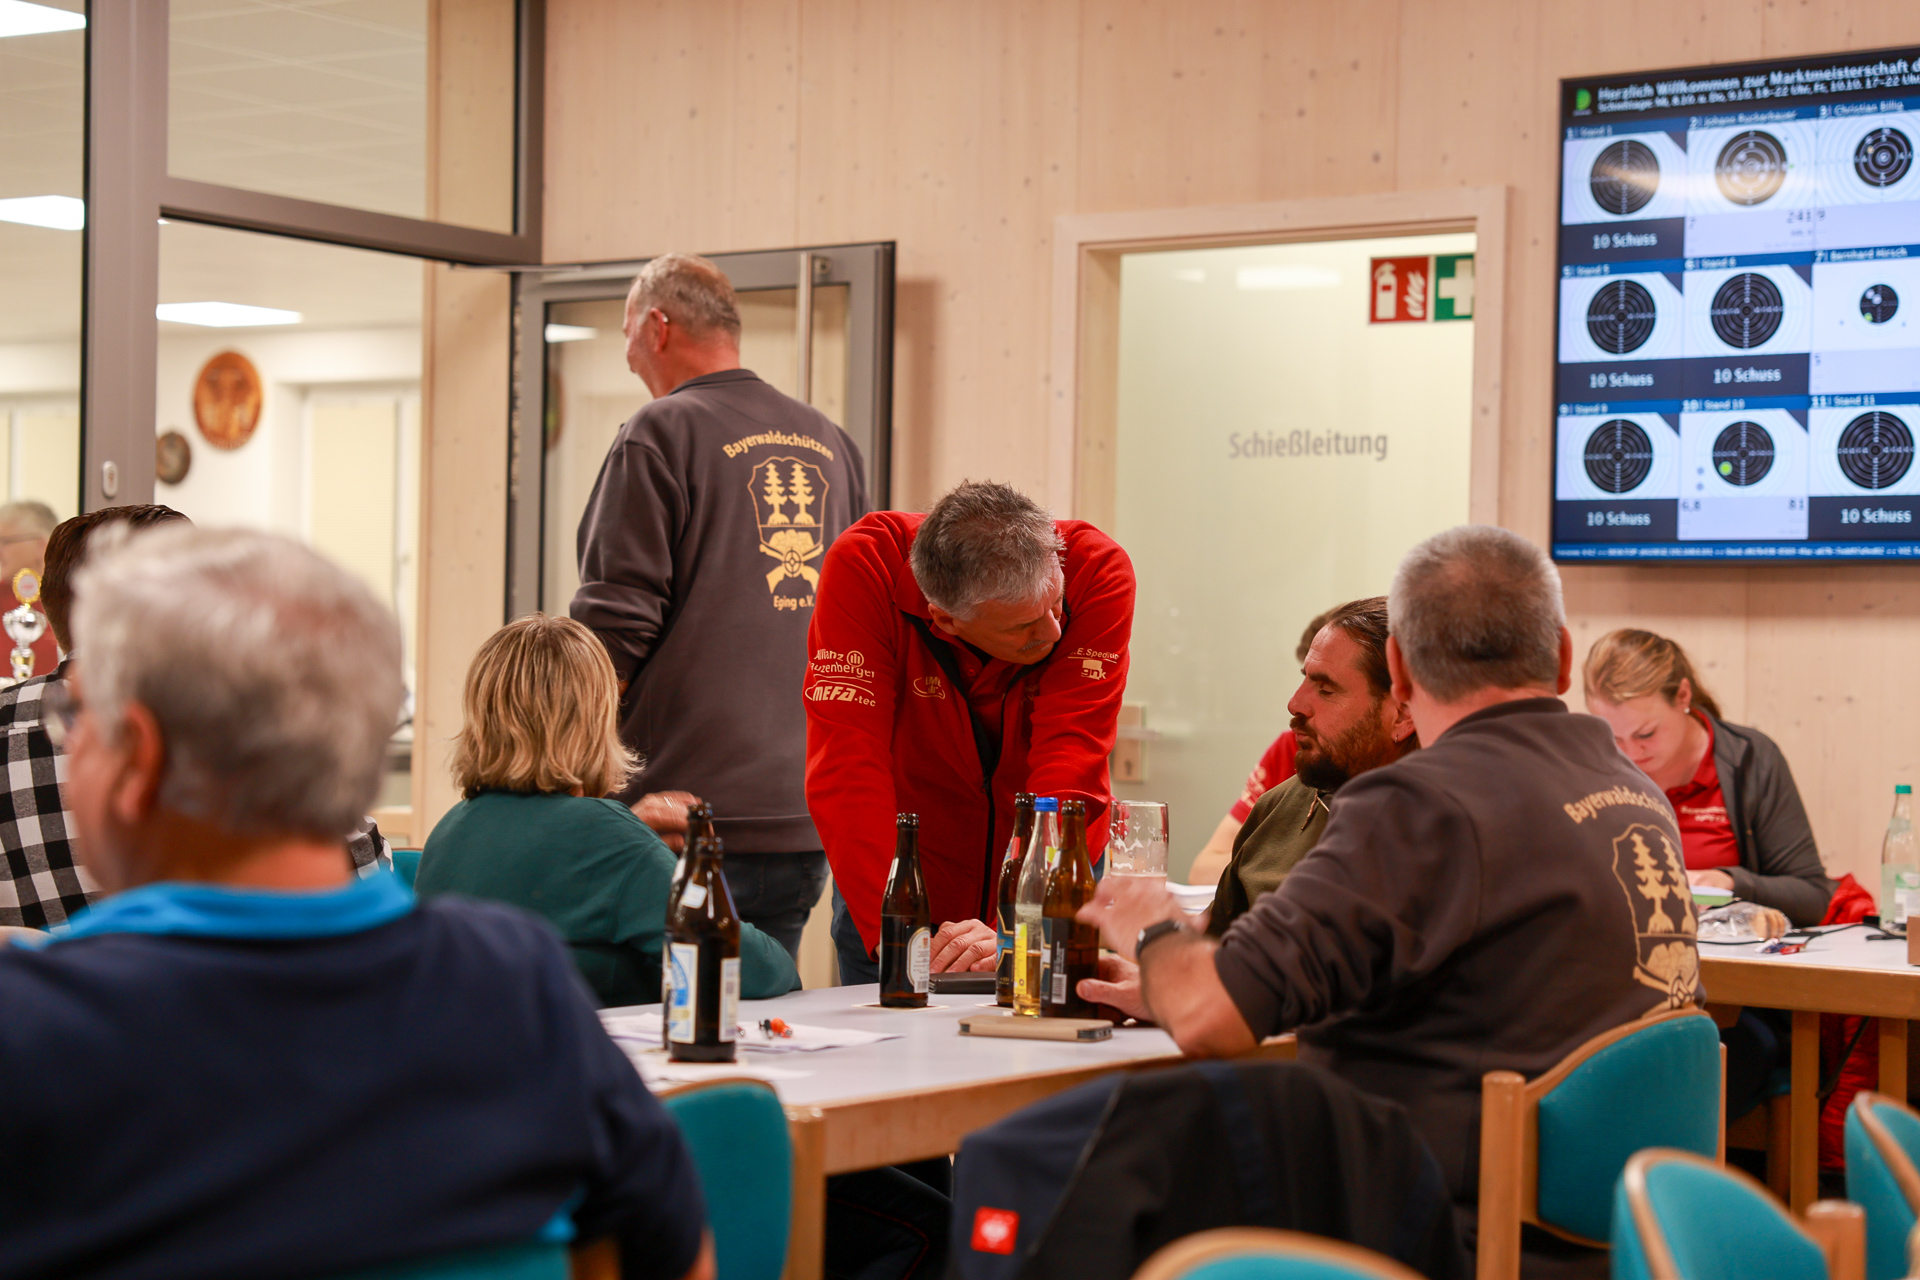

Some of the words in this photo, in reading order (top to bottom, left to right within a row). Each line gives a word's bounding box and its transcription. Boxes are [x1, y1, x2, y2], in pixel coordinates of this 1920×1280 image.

[1598, 83, 1654, 101] Herzlich
[1656, 78, 1741, 96] Willkommen
[1743, 75, 1767, 88] zur
[1769, 59, 1909, 86] Marktmeisterschaft
[1592, 233, 1610, 249] 10
[1612, 232, 1658, 248] Schuss
[1589, 374, 1607, 389] 10
[1608, 372, 1654, 388] Schuss
[1713, 368, 1732, 384] 10
[1733, 367, 1782, 383] Schuss
[722, 430, 834, 461] Bayerwaldschützen
[1228, 429, 1388, 462] Schießleitung
[1586, 512, 1604, 526] 10
[1605, 510, 1651, 526] Schuss
[1841, 509, 1859, 524] 10
[1862, 507, 1912, 523] Schuss
[773, 595, 797, 611] Eging
[814, 649, 844, 662] Allianz
